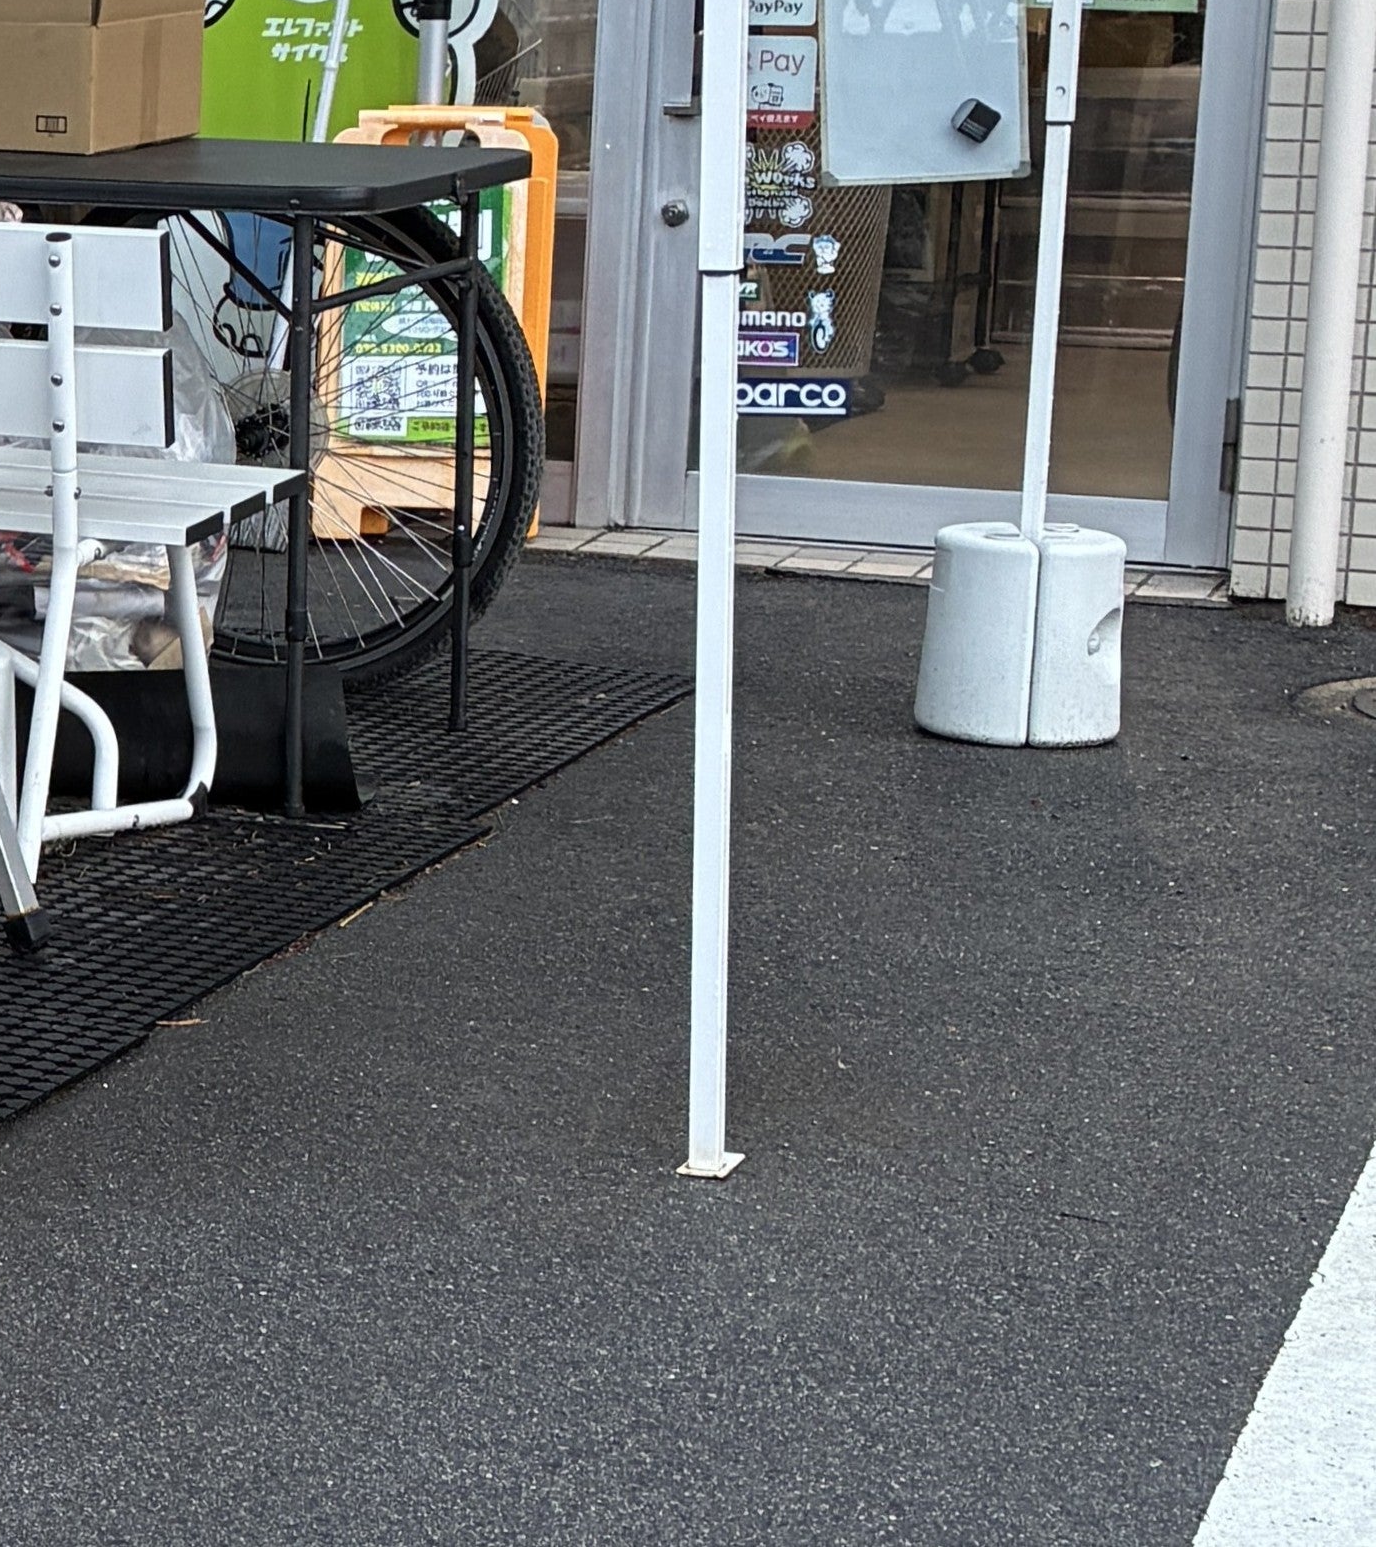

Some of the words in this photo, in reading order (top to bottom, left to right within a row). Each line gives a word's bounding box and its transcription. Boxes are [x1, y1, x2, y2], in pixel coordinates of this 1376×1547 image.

[262, 17, 364, 38] エレファト
[760, 50, 806, 76] Pay
[741, 310, 806, 328] MANO
[737, 382, 846, 407] parco
